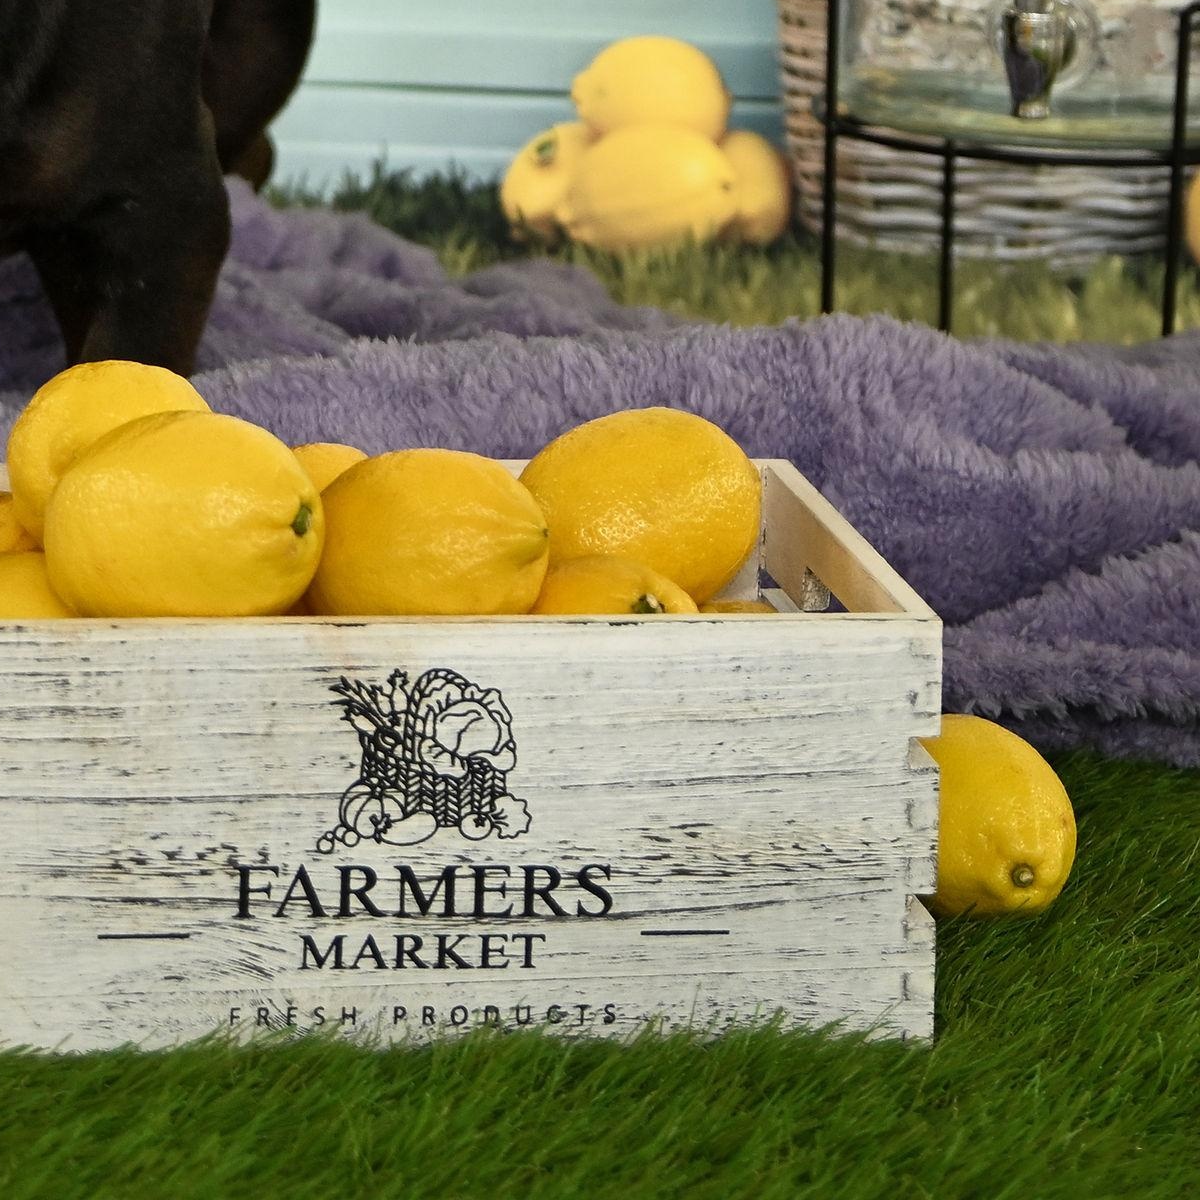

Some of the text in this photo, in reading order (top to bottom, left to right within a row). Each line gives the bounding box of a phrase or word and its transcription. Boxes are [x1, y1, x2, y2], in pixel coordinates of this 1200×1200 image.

[231, 863, 614, 919] FARMERS
[299, 932, 546, 970] MARKET
[229, 1003, 617, 1027] FRESH PRODUCTS
